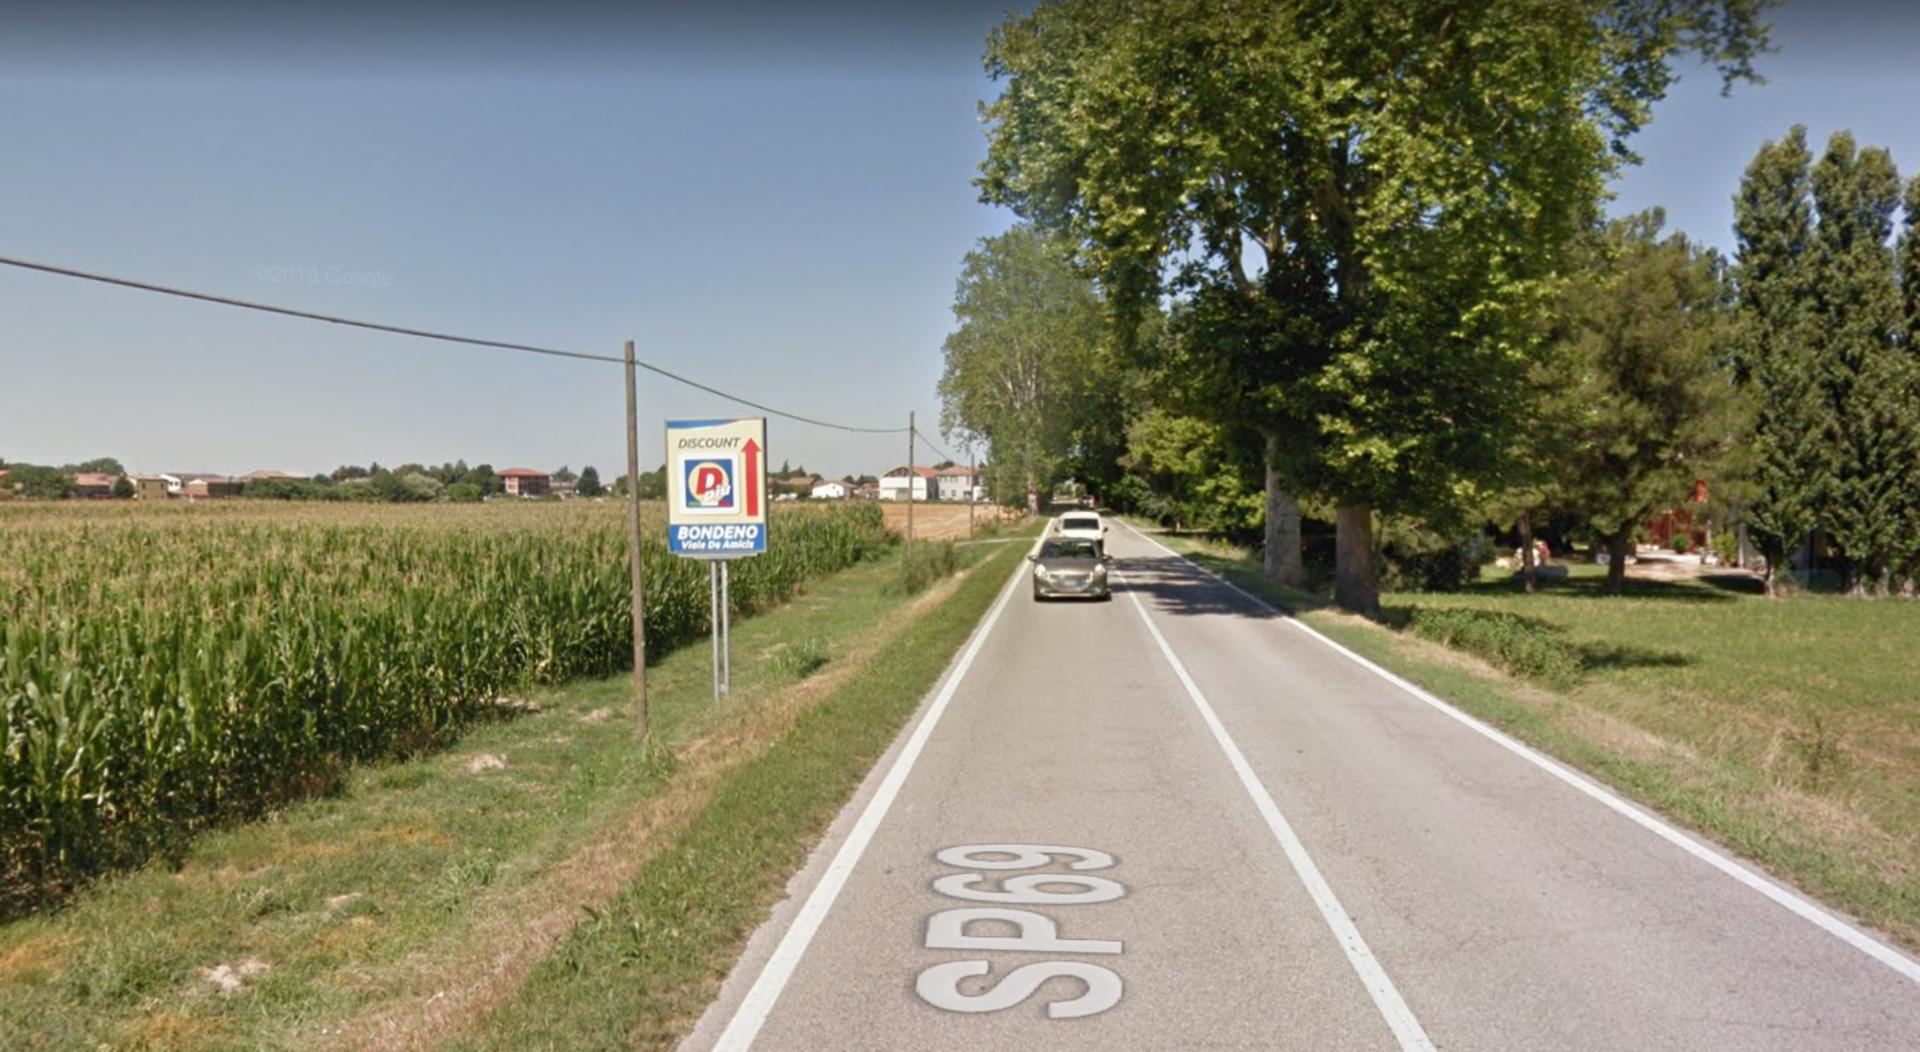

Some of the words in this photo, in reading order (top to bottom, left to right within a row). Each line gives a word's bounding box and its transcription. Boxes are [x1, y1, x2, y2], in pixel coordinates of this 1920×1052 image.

[678, 438, 741, 449] DISCOUNT
[677, 525, 759, 540] BONDENO
[707, 540, 721, 549] De
